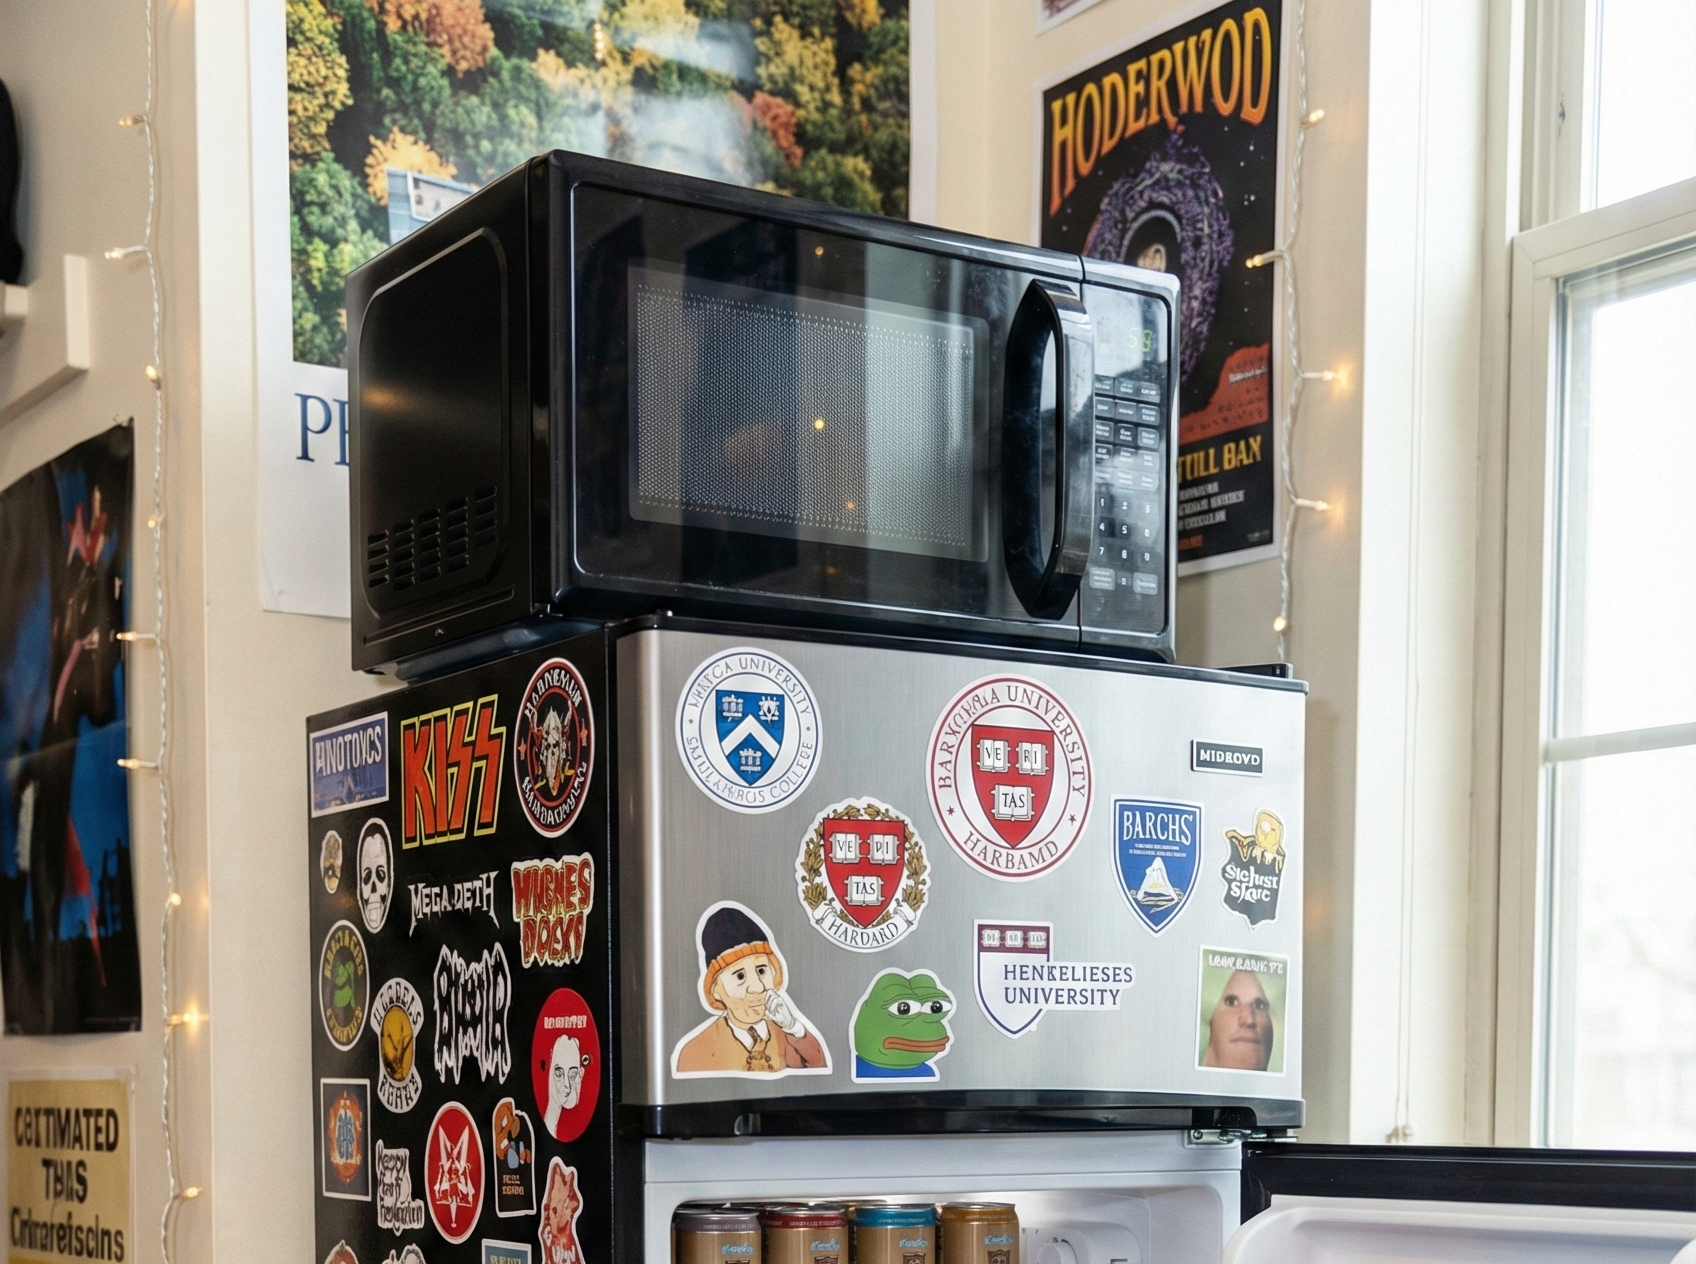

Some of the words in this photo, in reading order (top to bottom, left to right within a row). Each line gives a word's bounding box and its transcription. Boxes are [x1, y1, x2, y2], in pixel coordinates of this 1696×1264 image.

[1050, 7, 1272, 217] HODERWOD
[738, 657, 812, 716] UNIVERSITY
[984, 746, 1002, 762] VE
[1006, 684, 1086, 798] UNIVERSITY
[402, 695, 507, 848] KISS
[1002, 792, 1025, 809] TAS
[1123, 811, 1194, 846] BARCHS
[853, 881, 876, 895] TAS
[1004, 986, 1121, 1006] UNIVERSITY
